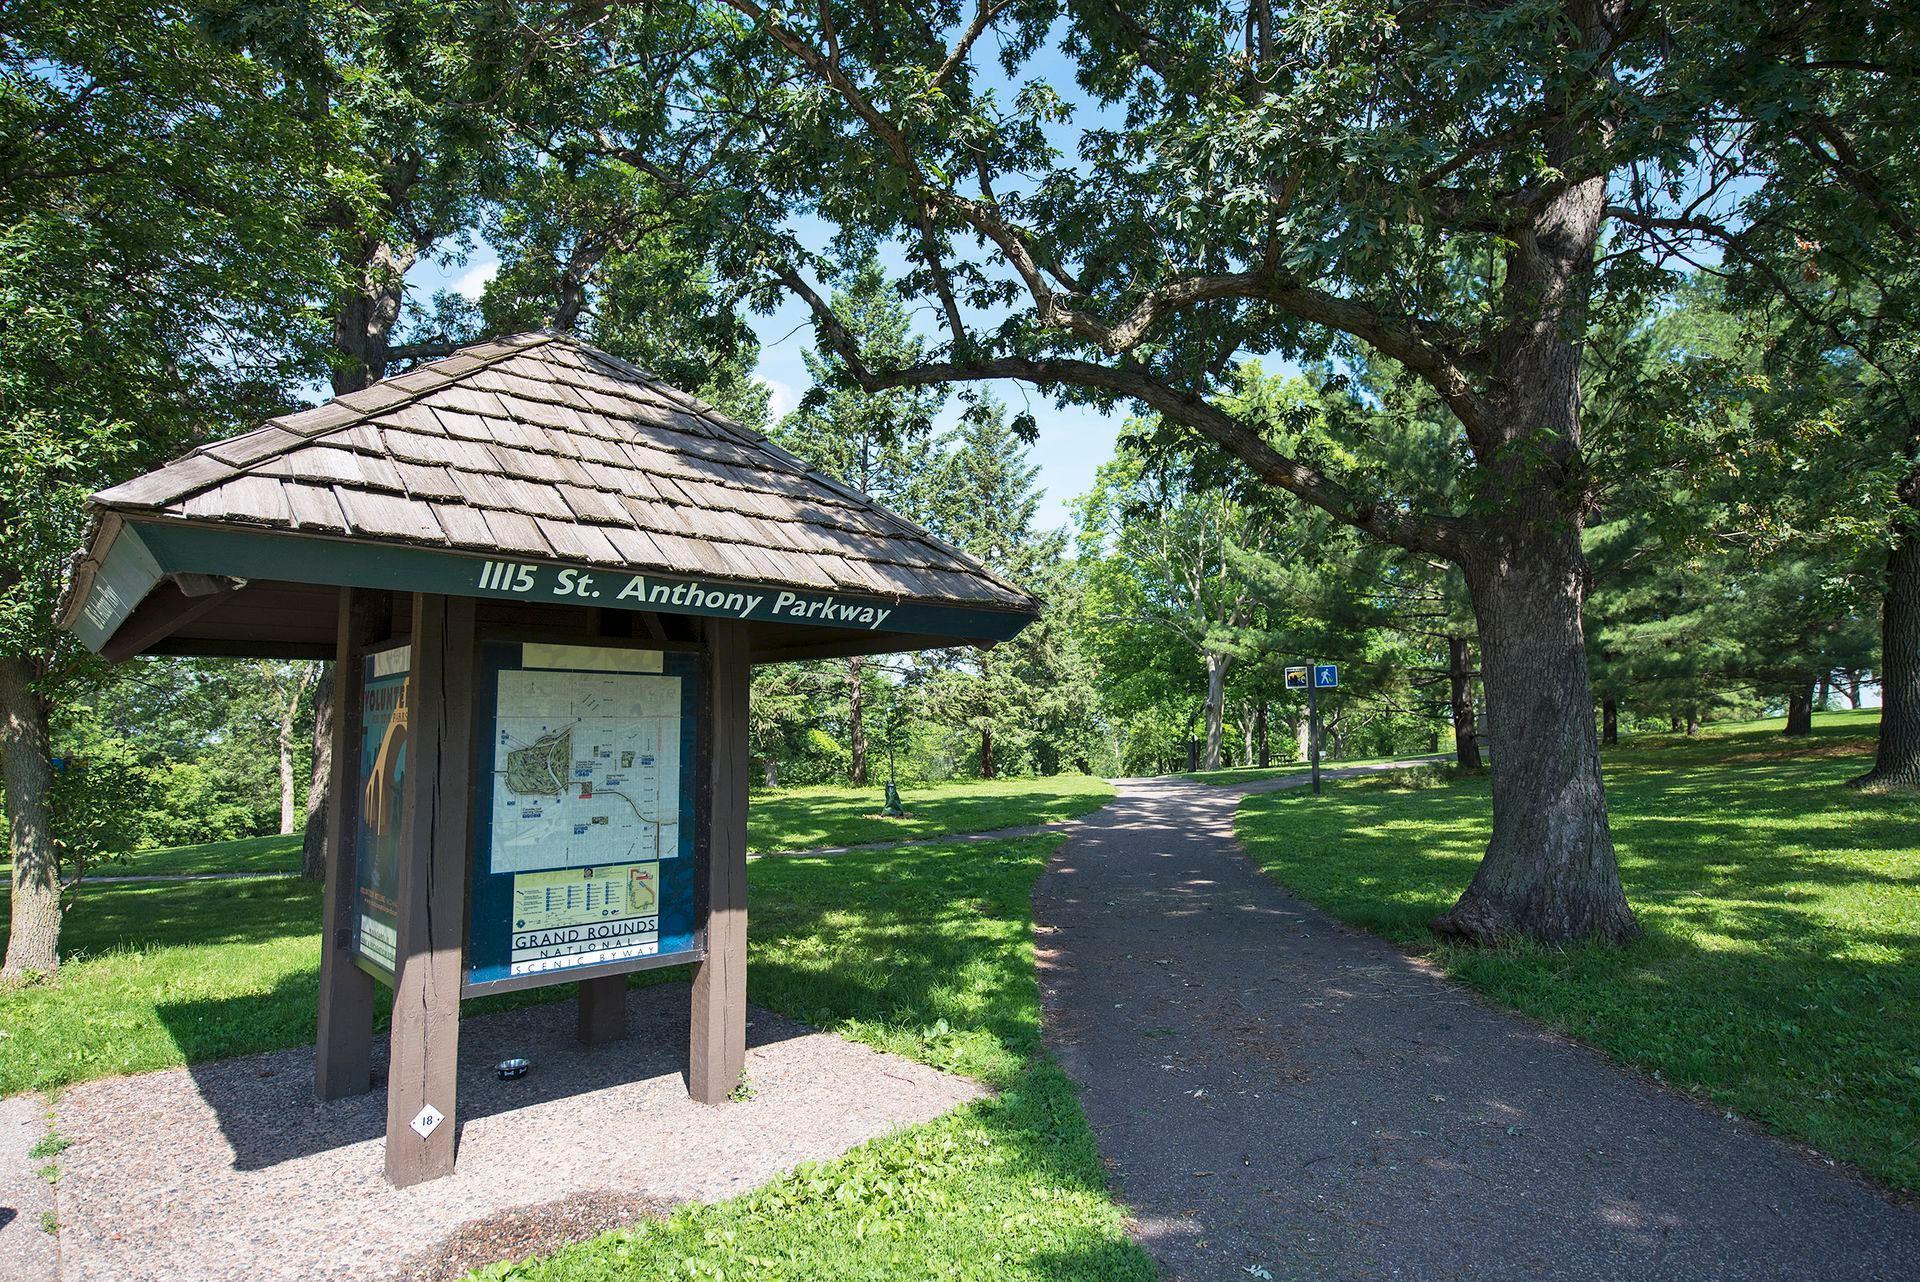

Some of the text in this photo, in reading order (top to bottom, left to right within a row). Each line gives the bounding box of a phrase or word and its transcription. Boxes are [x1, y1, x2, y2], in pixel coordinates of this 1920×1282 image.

[478, 561, 891, 630] 1115 St. Anthony Parkway
[515, 930, 579, 948] GRAND
[588, 920, 655, 939] ROUNDS
[516, 947, 654, 974] SCENIC BYWAY
[540, 938, 633, 958] NATIONAL
[422, 1115, 433, 1126] 18
